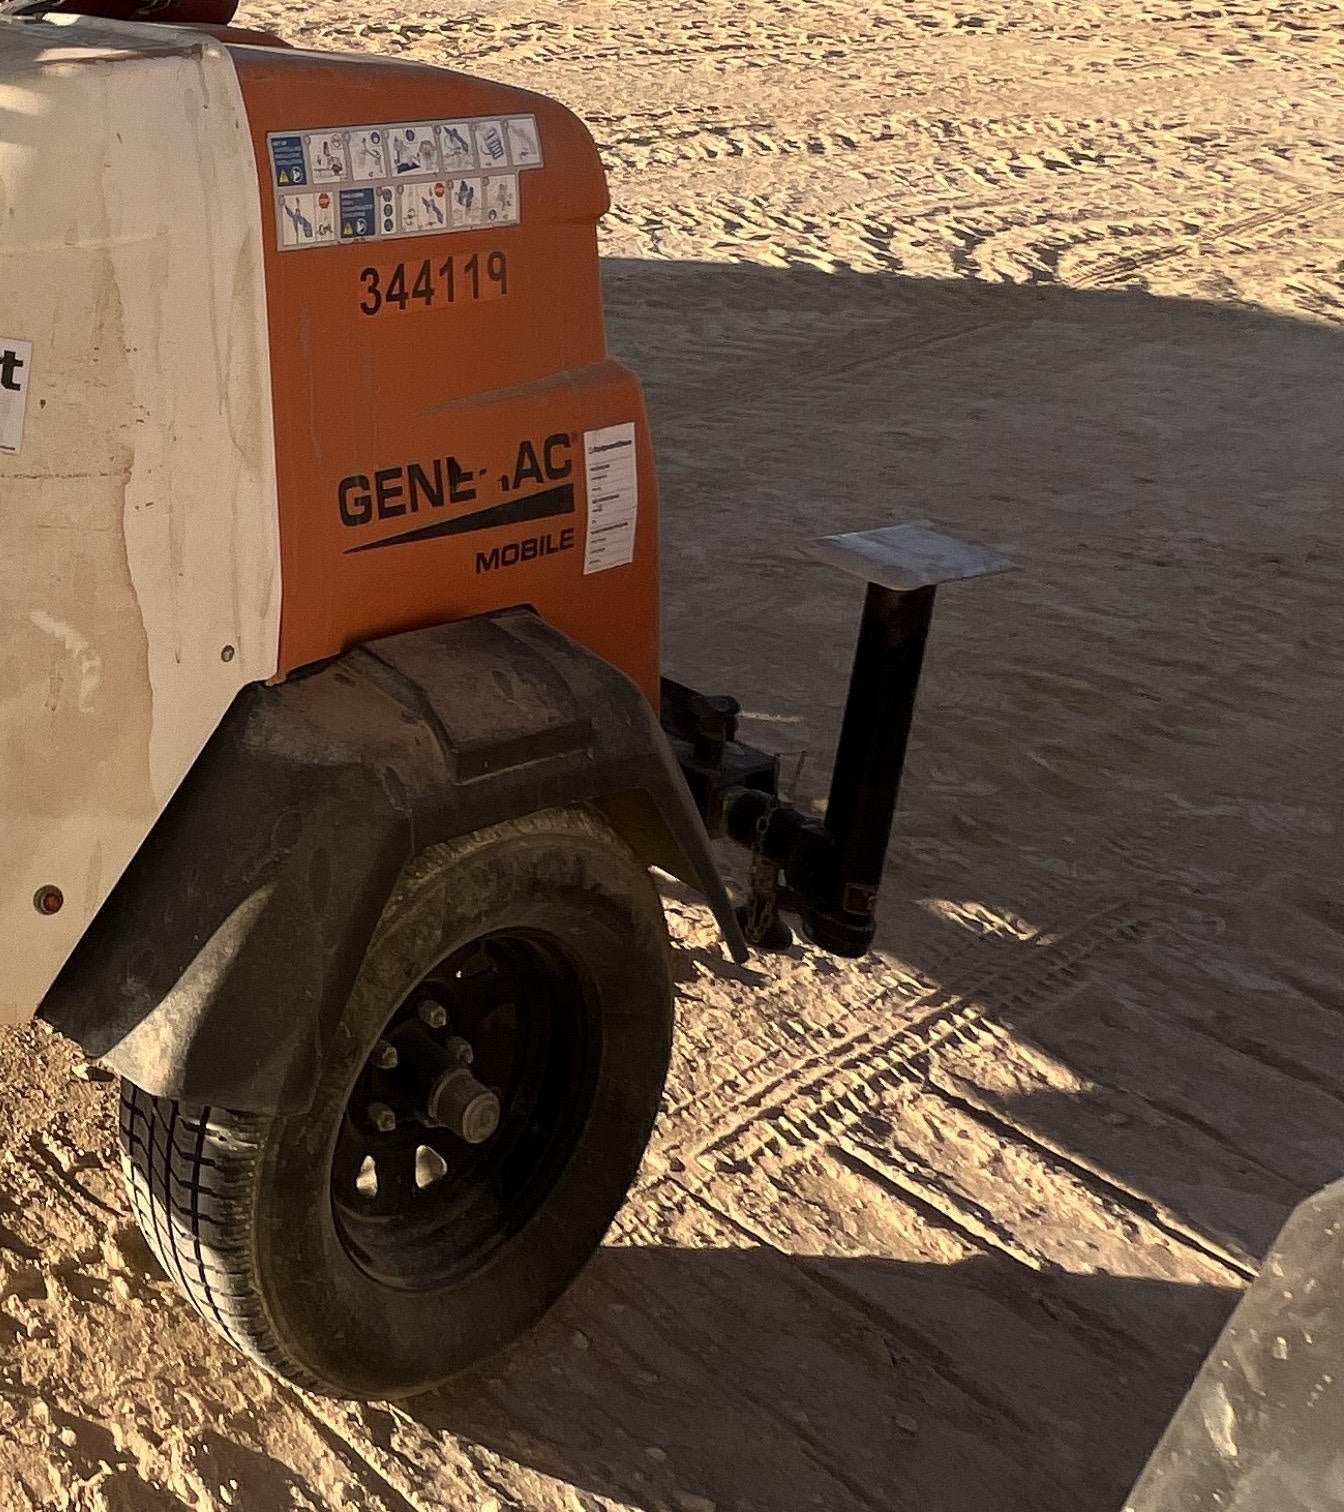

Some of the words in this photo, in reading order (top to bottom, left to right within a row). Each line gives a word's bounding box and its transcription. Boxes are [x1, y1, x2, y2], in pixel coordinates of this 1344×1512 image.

[360, 251, 508, 316] 344119
[338, 433, 572, 527] GENEAC
[475, 528, 575, 575] MOBILE
